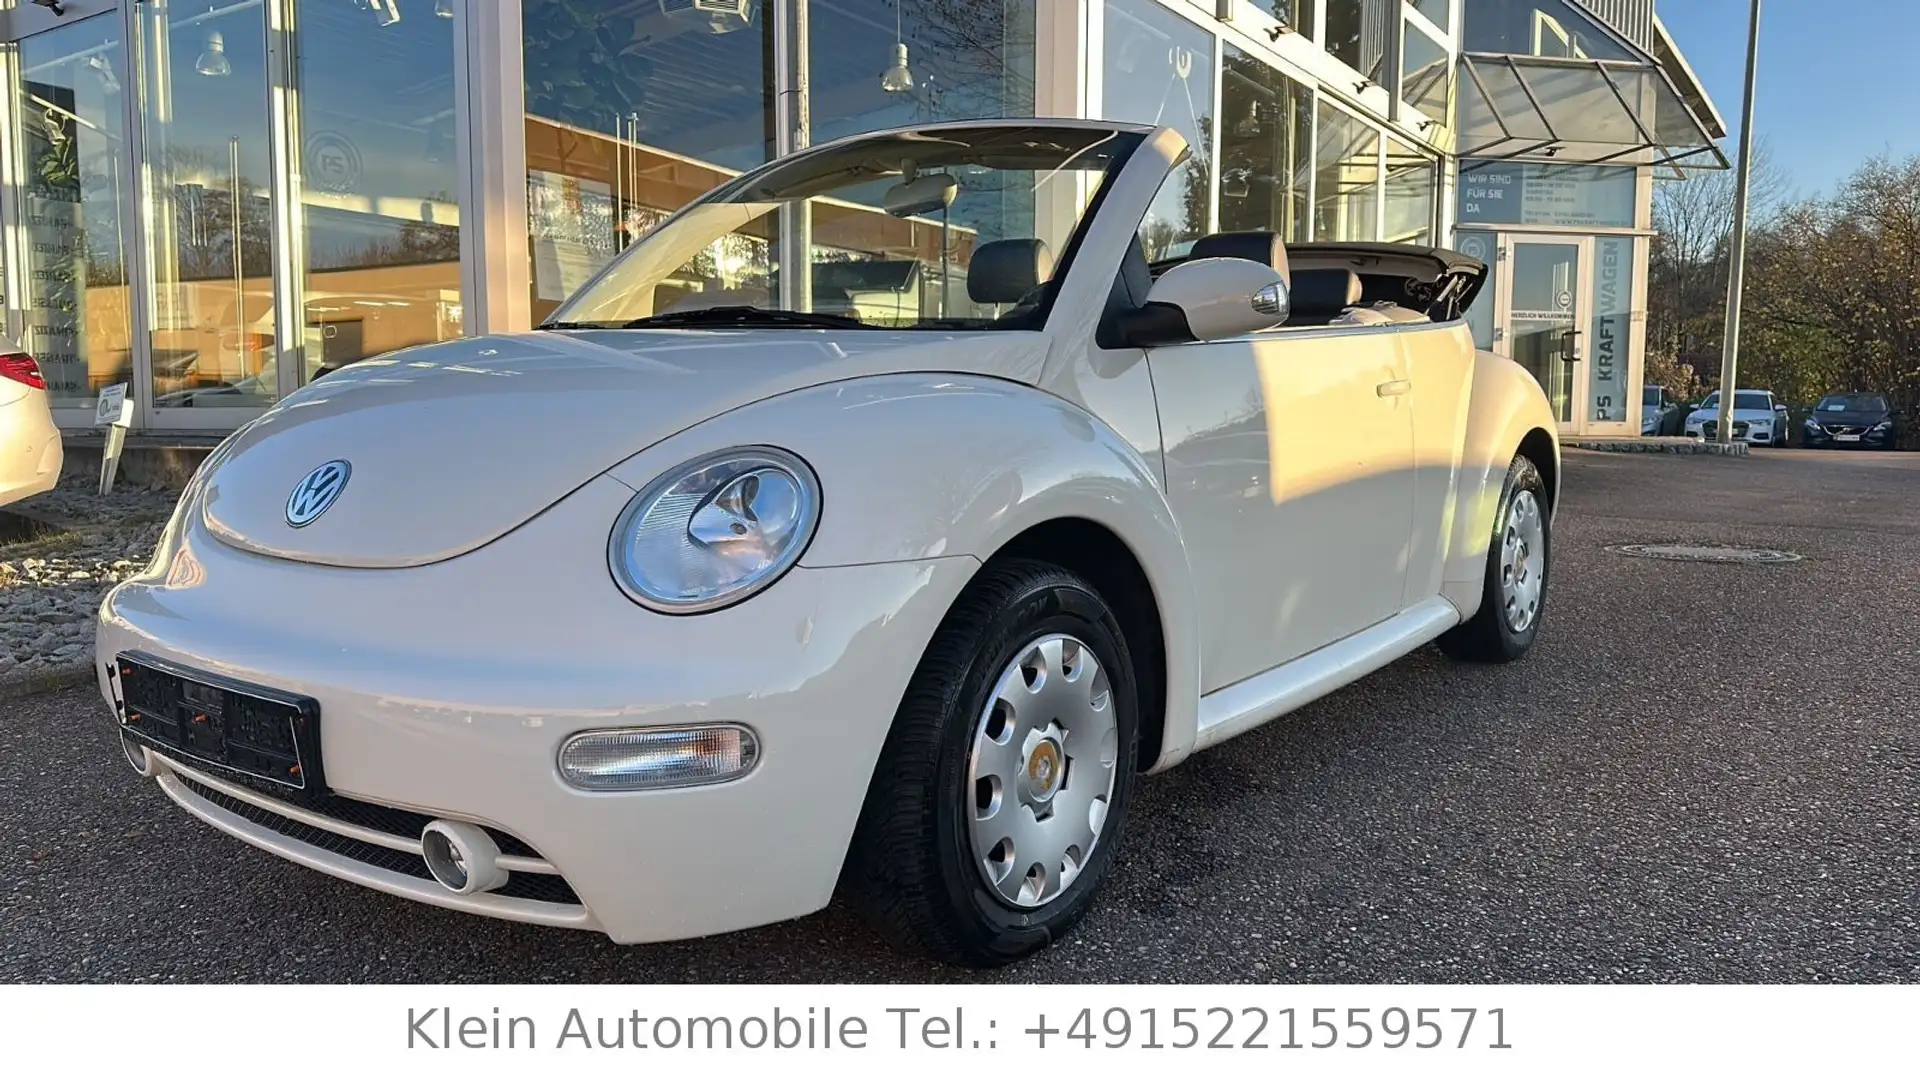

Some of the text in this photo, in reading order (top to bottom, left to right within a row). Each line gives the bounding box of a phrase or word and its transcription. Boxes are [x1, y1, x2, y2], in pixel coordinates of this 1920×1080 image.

[1467, 173, 1487, 184] WIR
[1489, 174, 1512, 185] SIND
[1466, 186, 1504, 199] FÜR SIE
[1466, 203, 1480, 213] DA
[1596, 241, 1619, 421] PS KRAFTWAGEN
